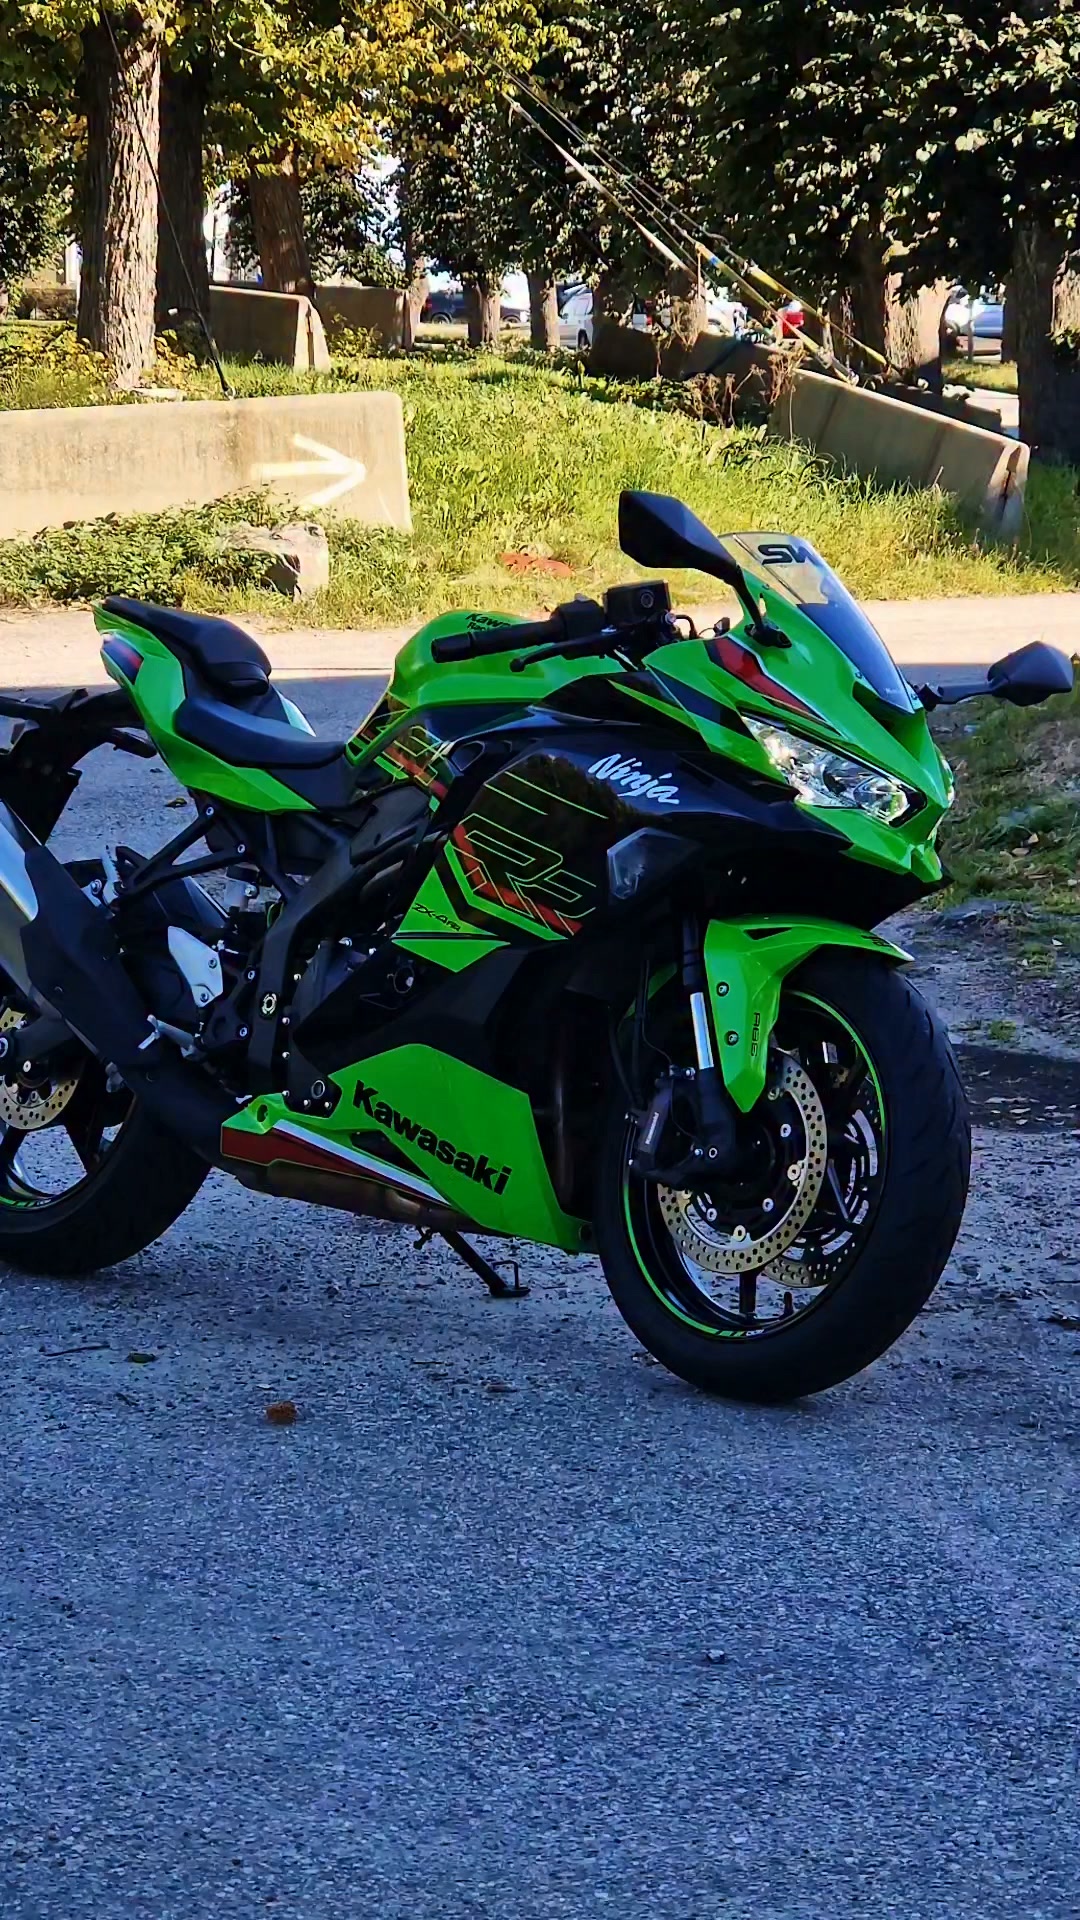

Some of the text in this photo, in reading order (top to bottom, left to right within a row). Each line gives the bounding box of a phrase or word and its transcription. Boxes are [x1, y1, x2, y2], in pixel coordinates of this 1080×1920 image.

[587, 753, 680, 805] Ninja
[750, 1011, 761, 1057] ABS
[352, 1079, 513, 1196] Kawasaki
